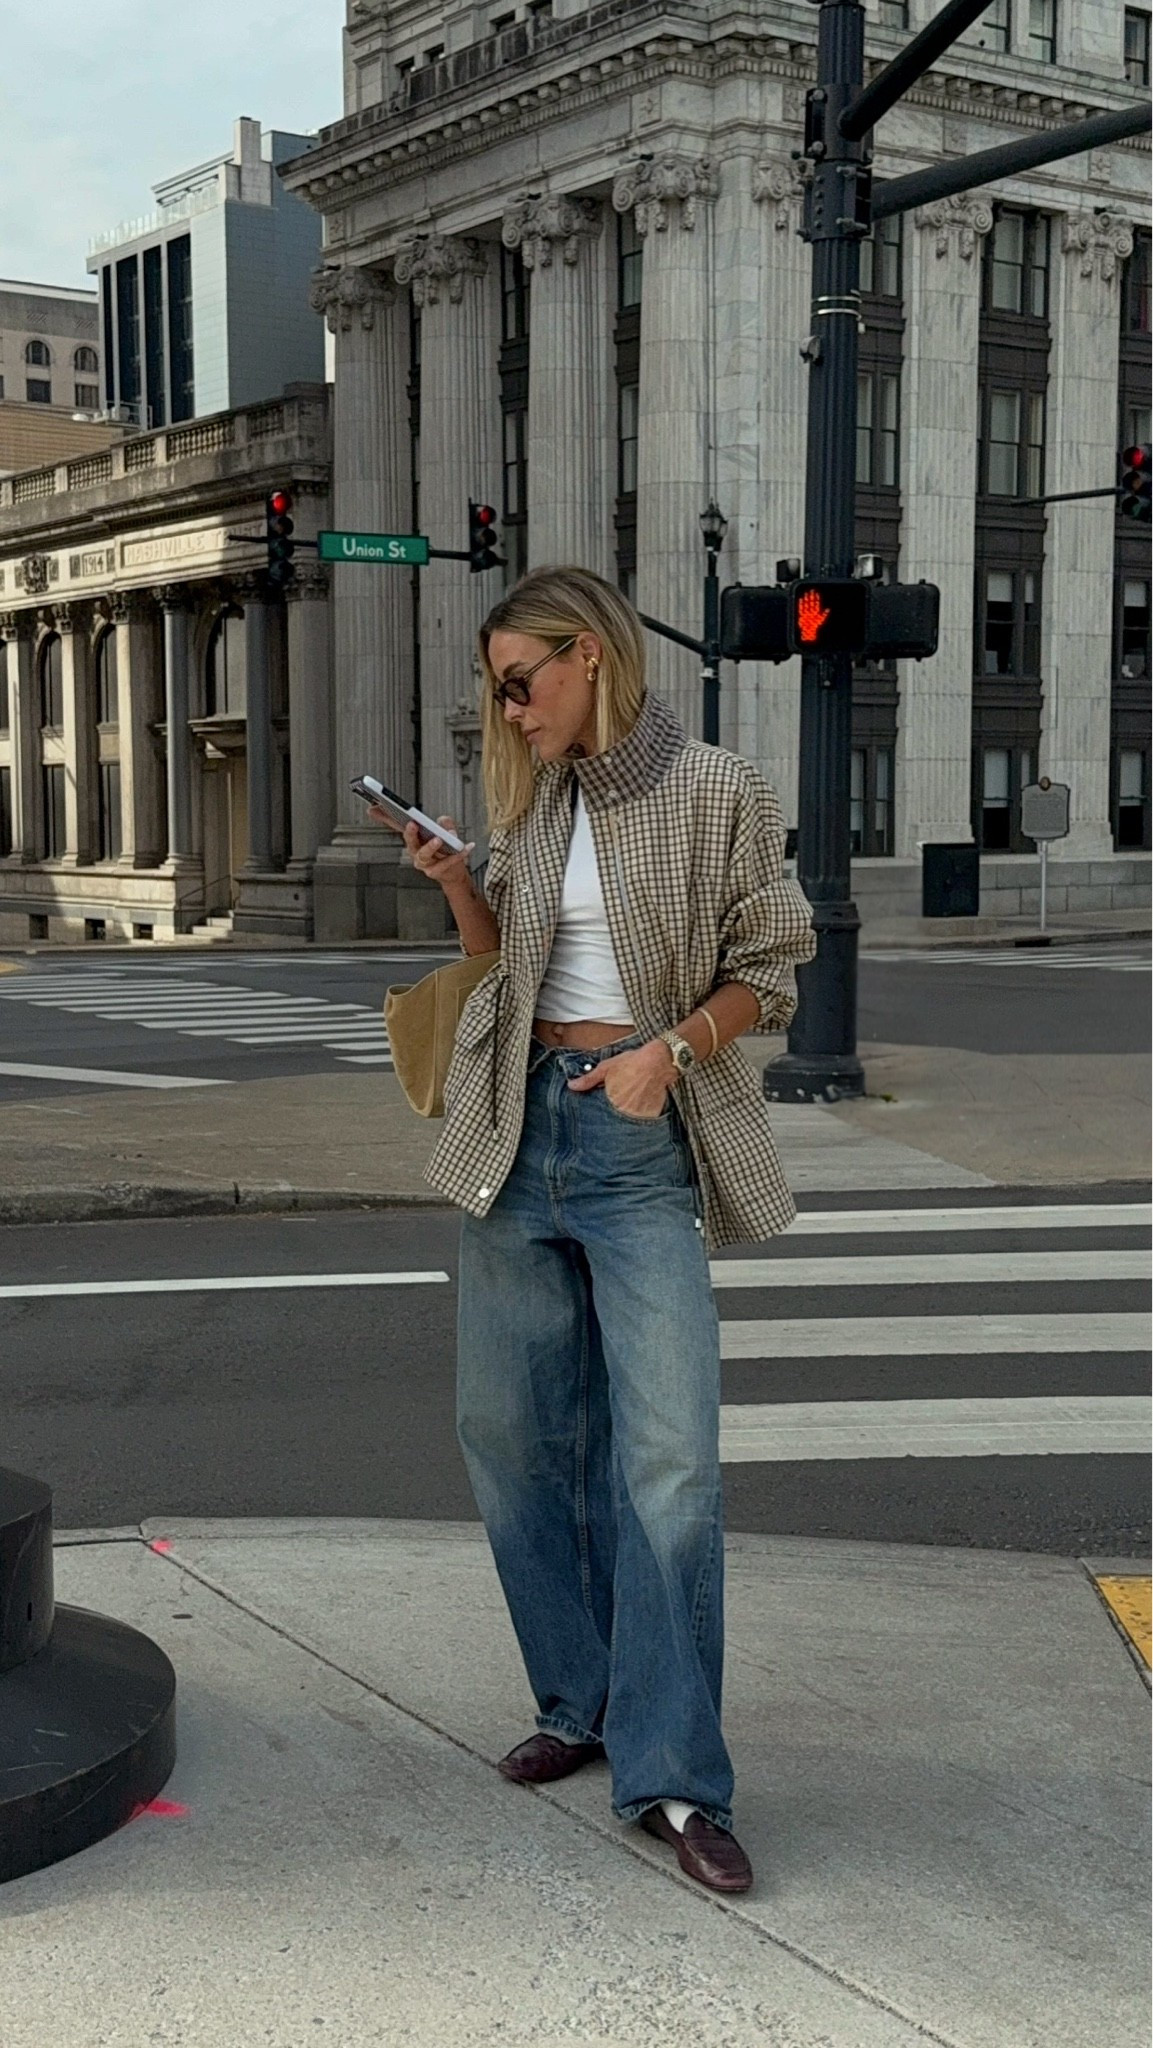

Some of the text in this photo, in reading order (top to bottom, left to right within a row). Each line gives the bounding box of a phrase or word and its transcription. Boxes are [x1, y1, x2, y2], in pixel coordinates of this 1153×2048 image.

[126, 534, 206, 563] NASHVILLE
[342, 537, 406, 558] Union St
